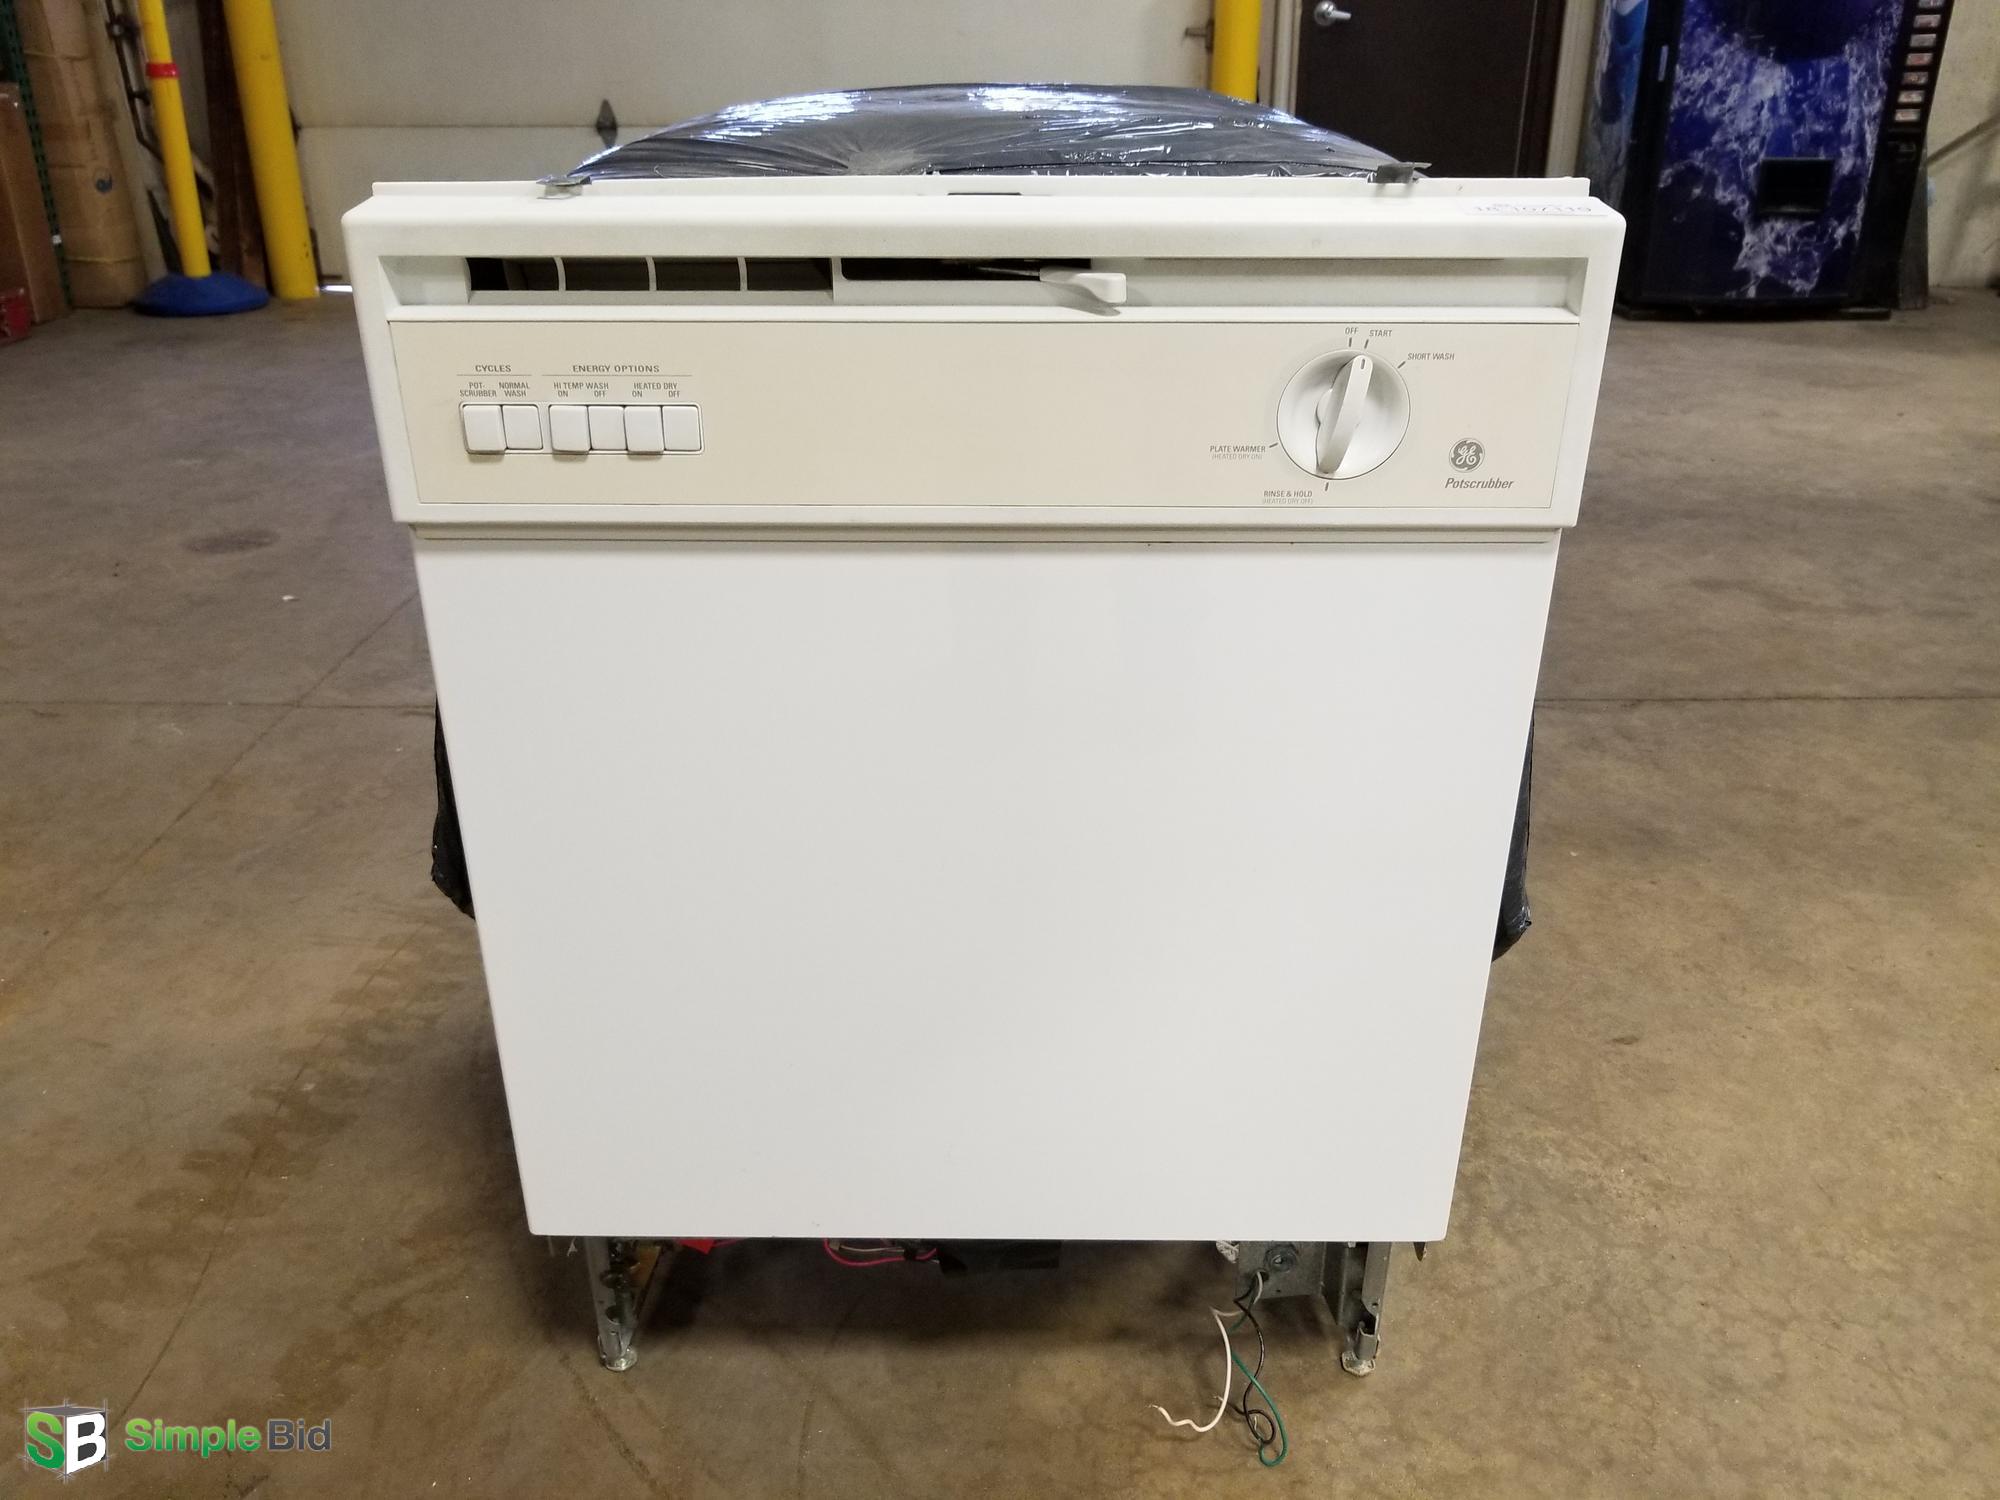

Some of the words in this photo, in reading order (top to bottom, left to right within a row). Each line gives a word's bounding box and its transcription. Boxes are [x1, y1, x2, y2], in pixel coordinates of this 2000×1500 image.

[1345, 327, 1358, 335] OFF
[1369, 329, 1392, 337] START
[1432, 353, 1455, 361] WASH
[475, 365, 511, 373] CYCLES
[572, 365, 610, 373] ENERGY
[614, 365, 660, 373] OPTIONS
[1210, 445, 1232, 453] PLATE
[1233, 445, 1266, 453] WARMER
[1445, 477, 1514, 489] Potscrubber
[1264, 490, 1285, 498] RINSE
[1286, 490, 1292, 498] &
[1294, 490, 1313, 498] HOLD
